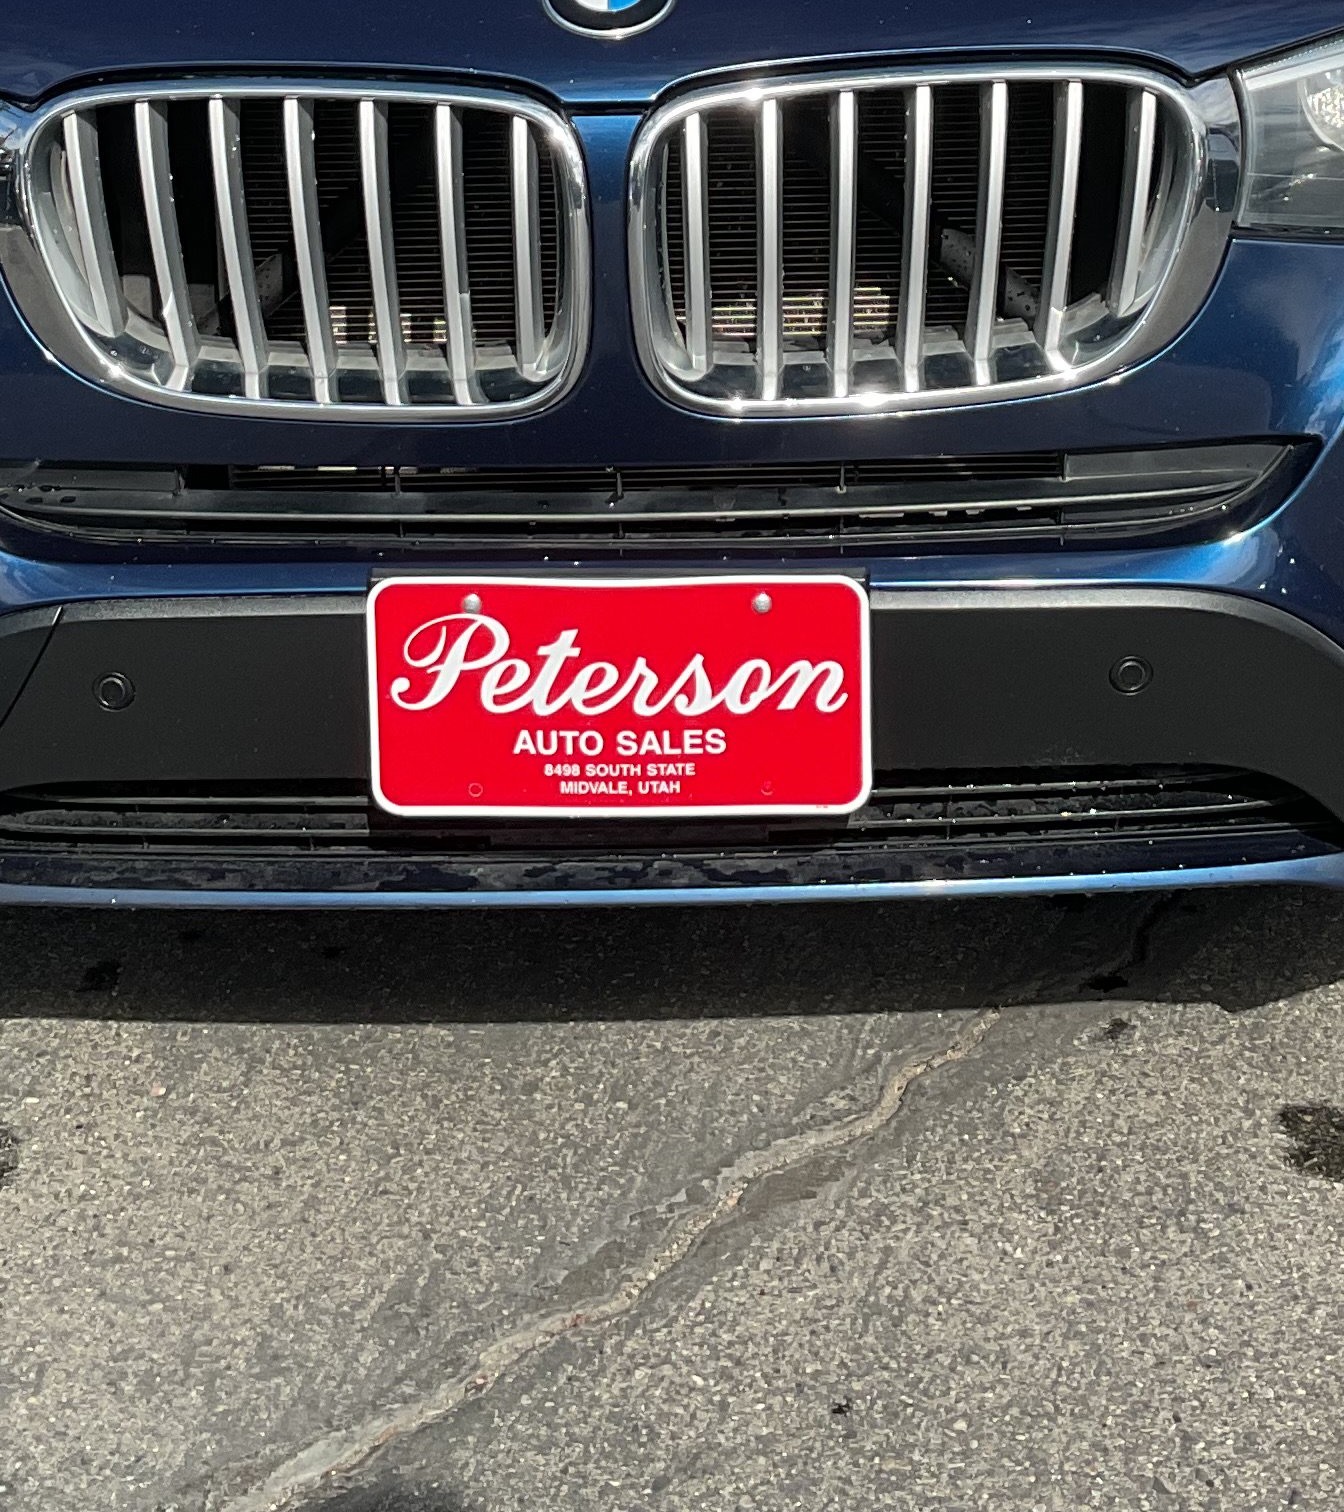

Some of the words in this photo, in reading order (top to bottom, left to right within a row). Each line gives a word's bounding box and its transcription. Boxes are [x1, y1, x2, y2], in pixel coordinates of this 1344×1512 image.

[391, 613, 849, 717] Peterson
[513, 729, 604, 756] AUTO
[616, 728, 727, 756] SALES
[544, 764, 580, 777] 8498
[585, 764, 641, 777] SOUTH
[647, 763, 695, 776] STATE
[560, 781, 632, 796] MIDVALE,
[638, 781, 681, 794] UTAH
